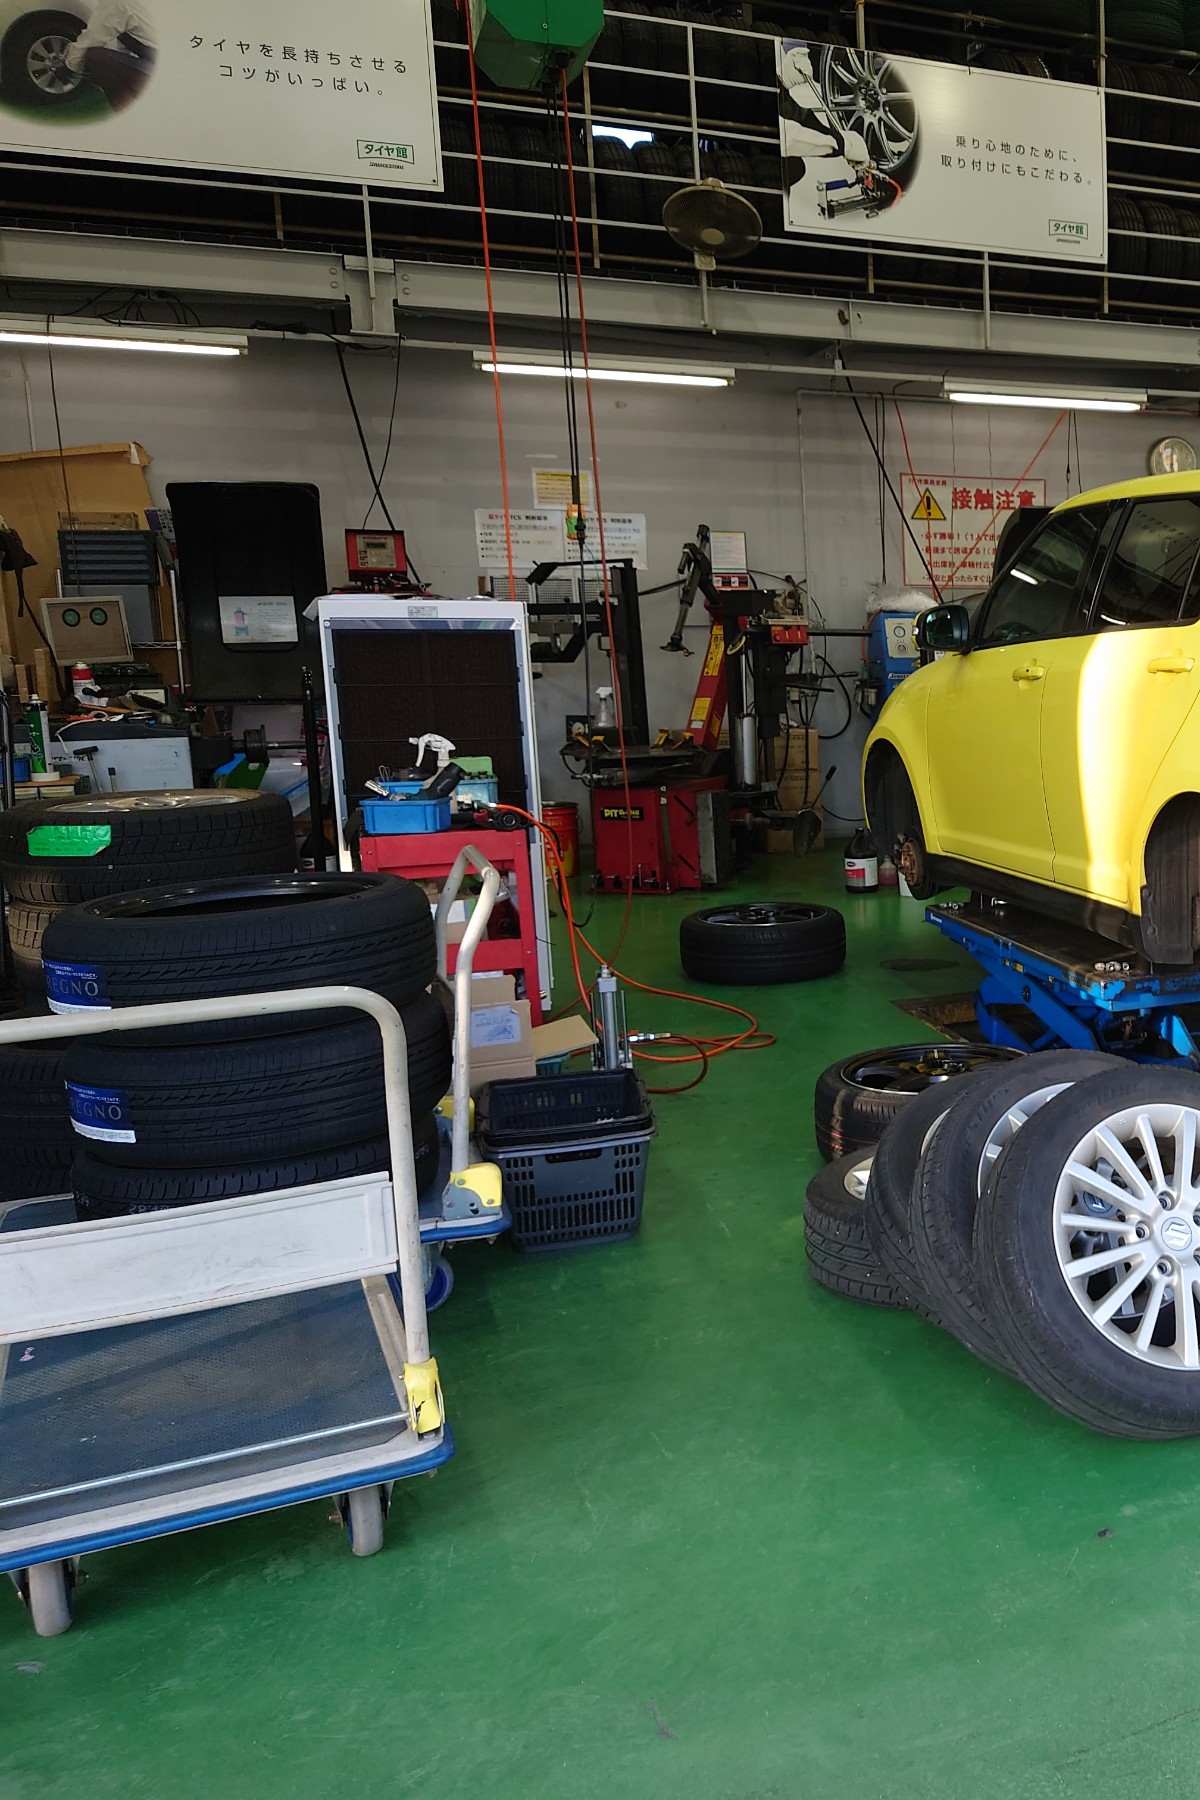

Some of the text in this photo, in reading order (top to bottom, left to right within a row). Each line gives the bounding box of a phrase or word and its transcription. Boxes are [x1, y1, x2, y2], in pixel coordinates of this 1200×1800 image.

[189, 35, 407, 74] タイヤを長持ちさせる
[219, 64, 383, 96] コツがいっぱい。
[364, 144, 408, 159] タイヤ館
[956, 135, 1077, 163] 乗り心地のために、
[941, 154, 1092, 185] 取り付けにもこだわる。
[1053, 222, 1084, 235] タイヤ館
[952, 487, 1036, 511] 接触注意
[46, 974, 99, 996] REGNO
